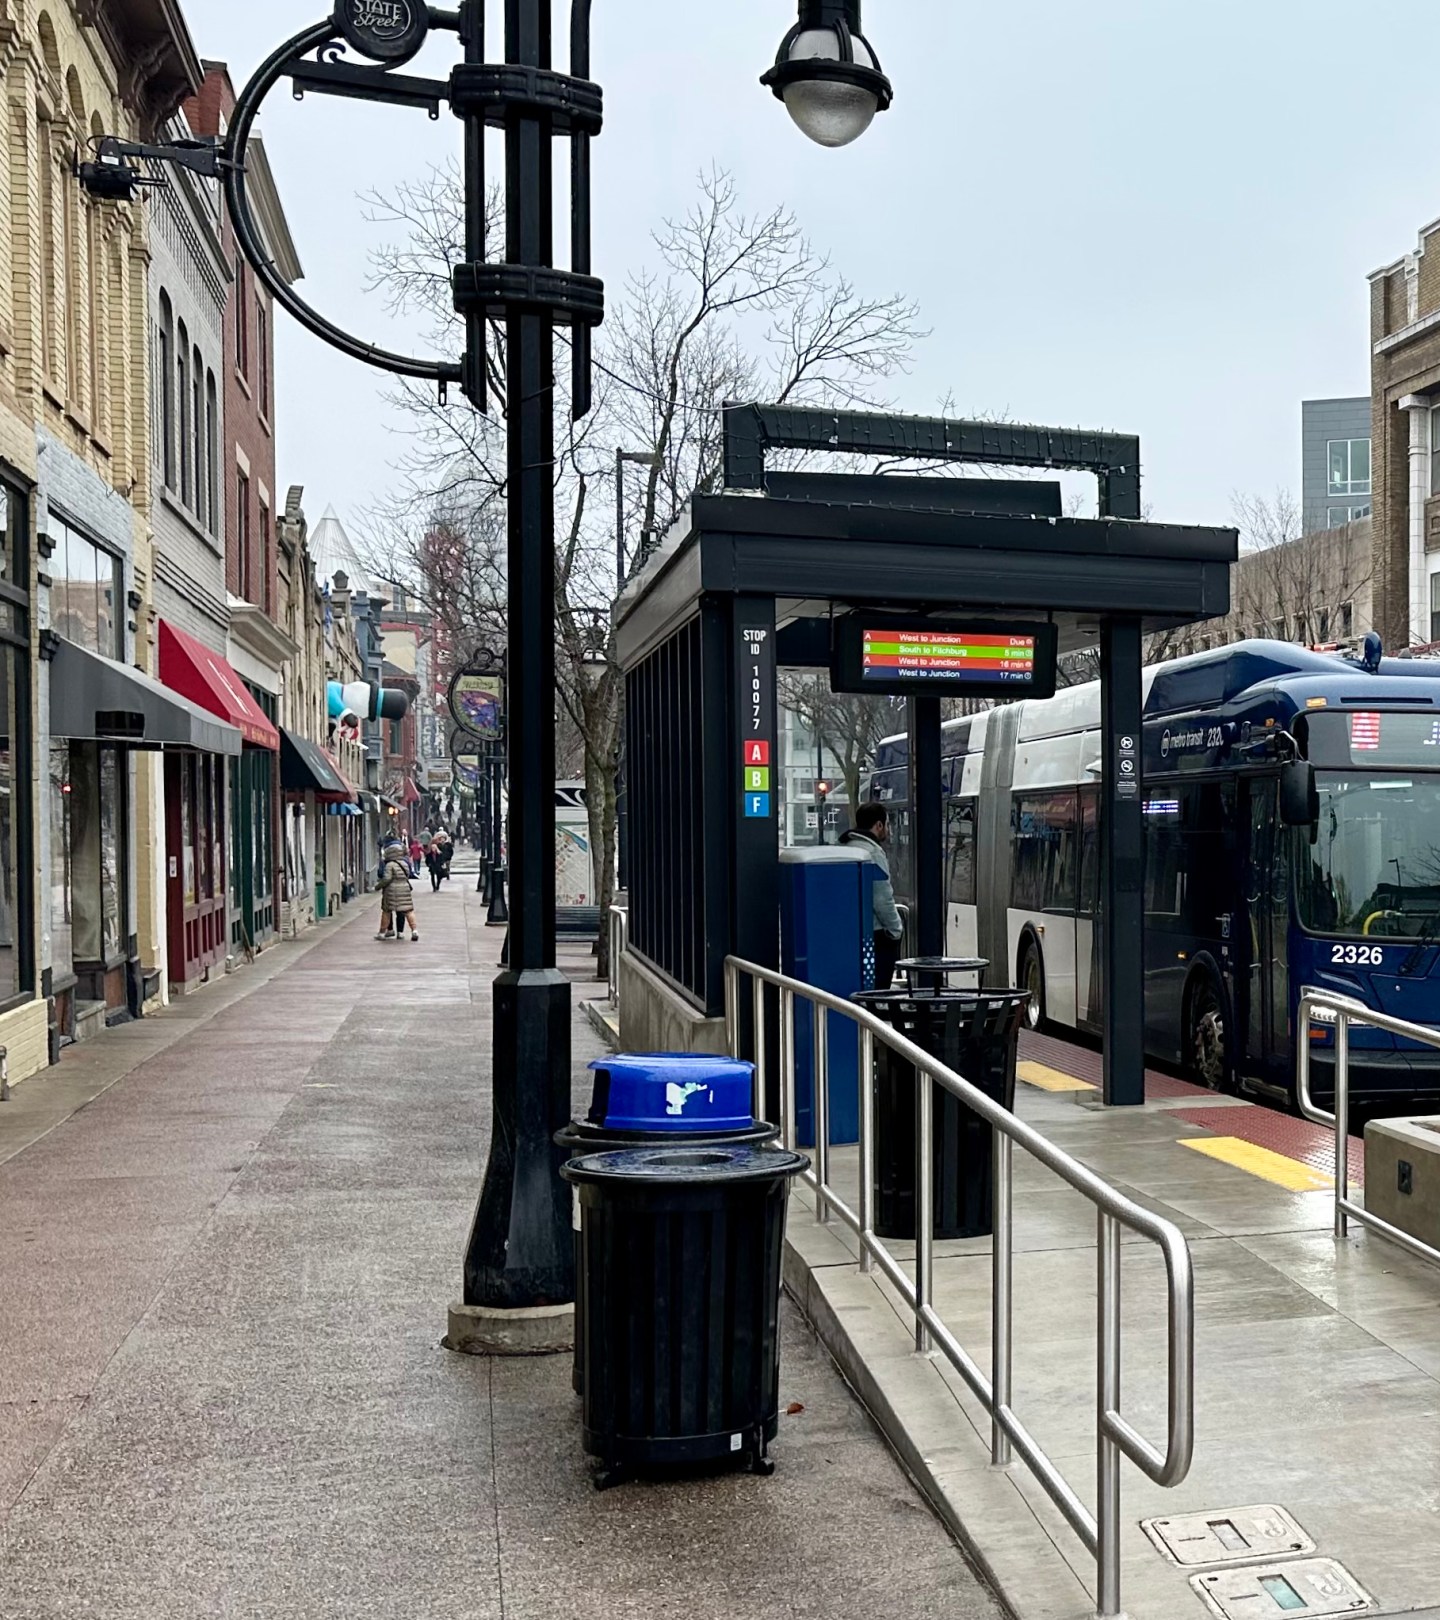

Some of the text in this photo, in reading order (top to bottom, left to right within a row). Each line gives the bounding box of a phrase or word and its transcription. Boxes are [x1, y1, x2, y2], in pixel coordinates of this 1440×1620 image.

[353, 0, 401, 19] STATE
[353, 12, 400, 27] Street
[743, 629, 767, 641] STOP
[863, 632, 1025, 646] A West to Junction Due
[750, 643, 760, 655] ID
[899, 645, 922, 654] South
[923, 646, 931, 654] to
[898, 656, 919, 666] West
[919, 658, 928, 666] to
[928, 658, 961, 667] Junction
[1000, 660, 1009, 668] 16
[897, 668, 919, 677] West
[919, 669, 928, 677] to
[927, 669, 960, 678] Junction
[999, 671, 1009, 679] 17
[1009, 672, 1024, 680] min
[752, 665, 760, 730] 10077
[1170, 732, 1187, 749] metro
[1186, 727, 1204, 747] transit
[751, 744, 762, 761] A
[752, 770, 762, 787] B
[752, 796, 761, 813] F
[1331, 945, 1383, 965] 2326
